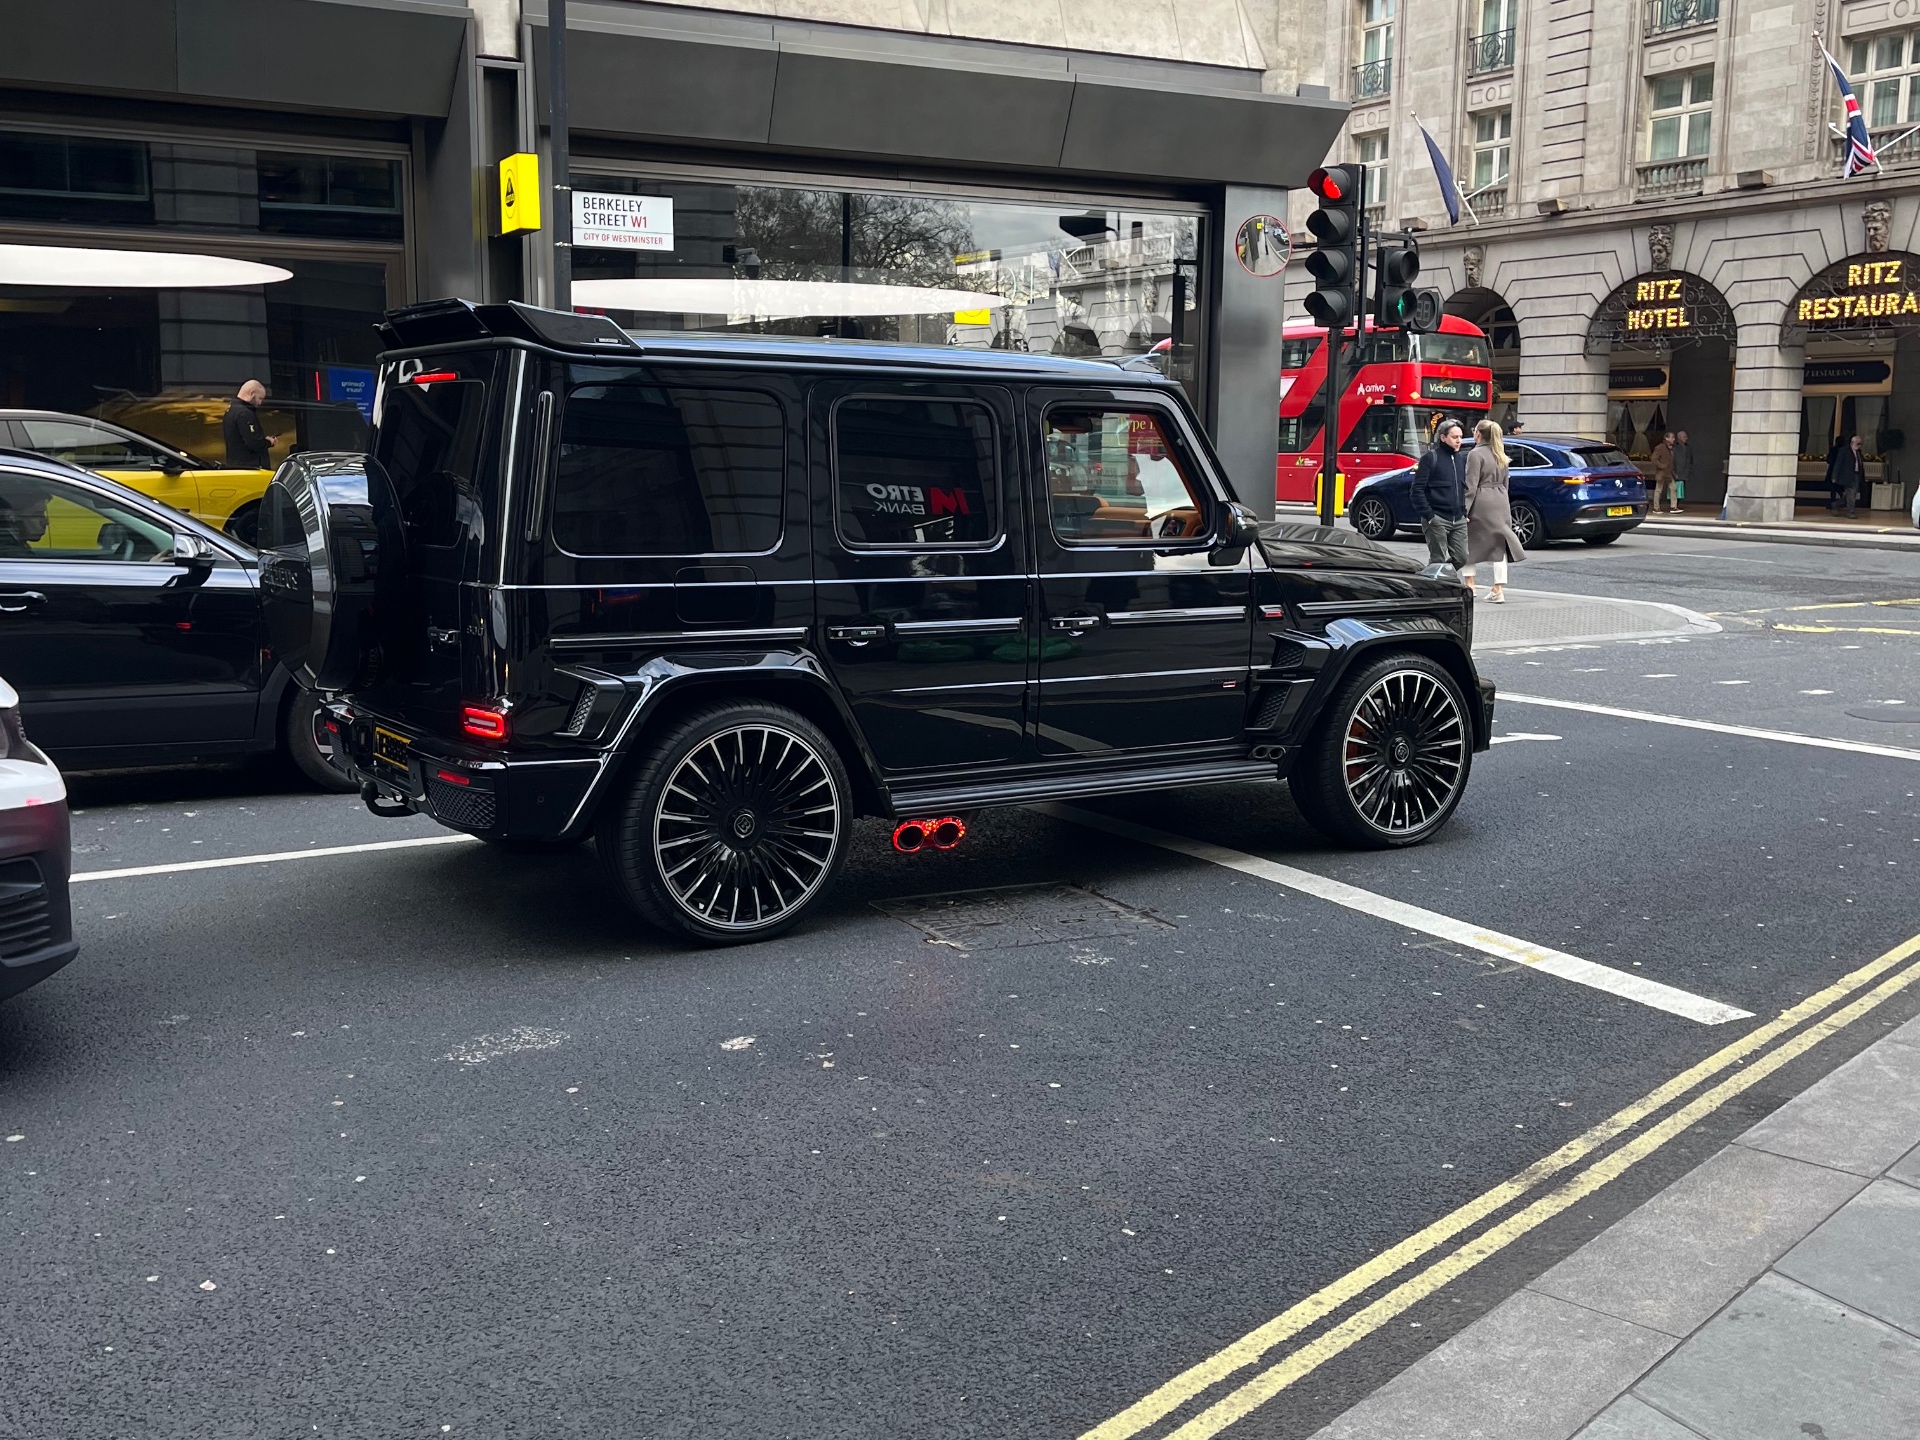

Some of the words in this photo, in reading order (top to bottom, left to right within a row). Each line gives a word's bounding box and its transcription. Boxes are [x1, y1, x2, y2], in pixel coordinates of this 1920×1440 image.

[583, 197, 643, 212] BERKELEY
[583, 212, 628, 227] STREET
[630, 215, 647, 228] W1
[583, 232, 600, 241] CITY
[601, 234, 610, 242] OF
[611, 235, 664, 245] WESTMINSTER
[1848, 260, 1902, 286] RITZ
[1636, 278, 1682, 301] RITZ
[1628, 306, 1690, 330] HOTEL
[1429, 382, 1457, 394] Victoria
[1468, 384, 1482, 398] 38
